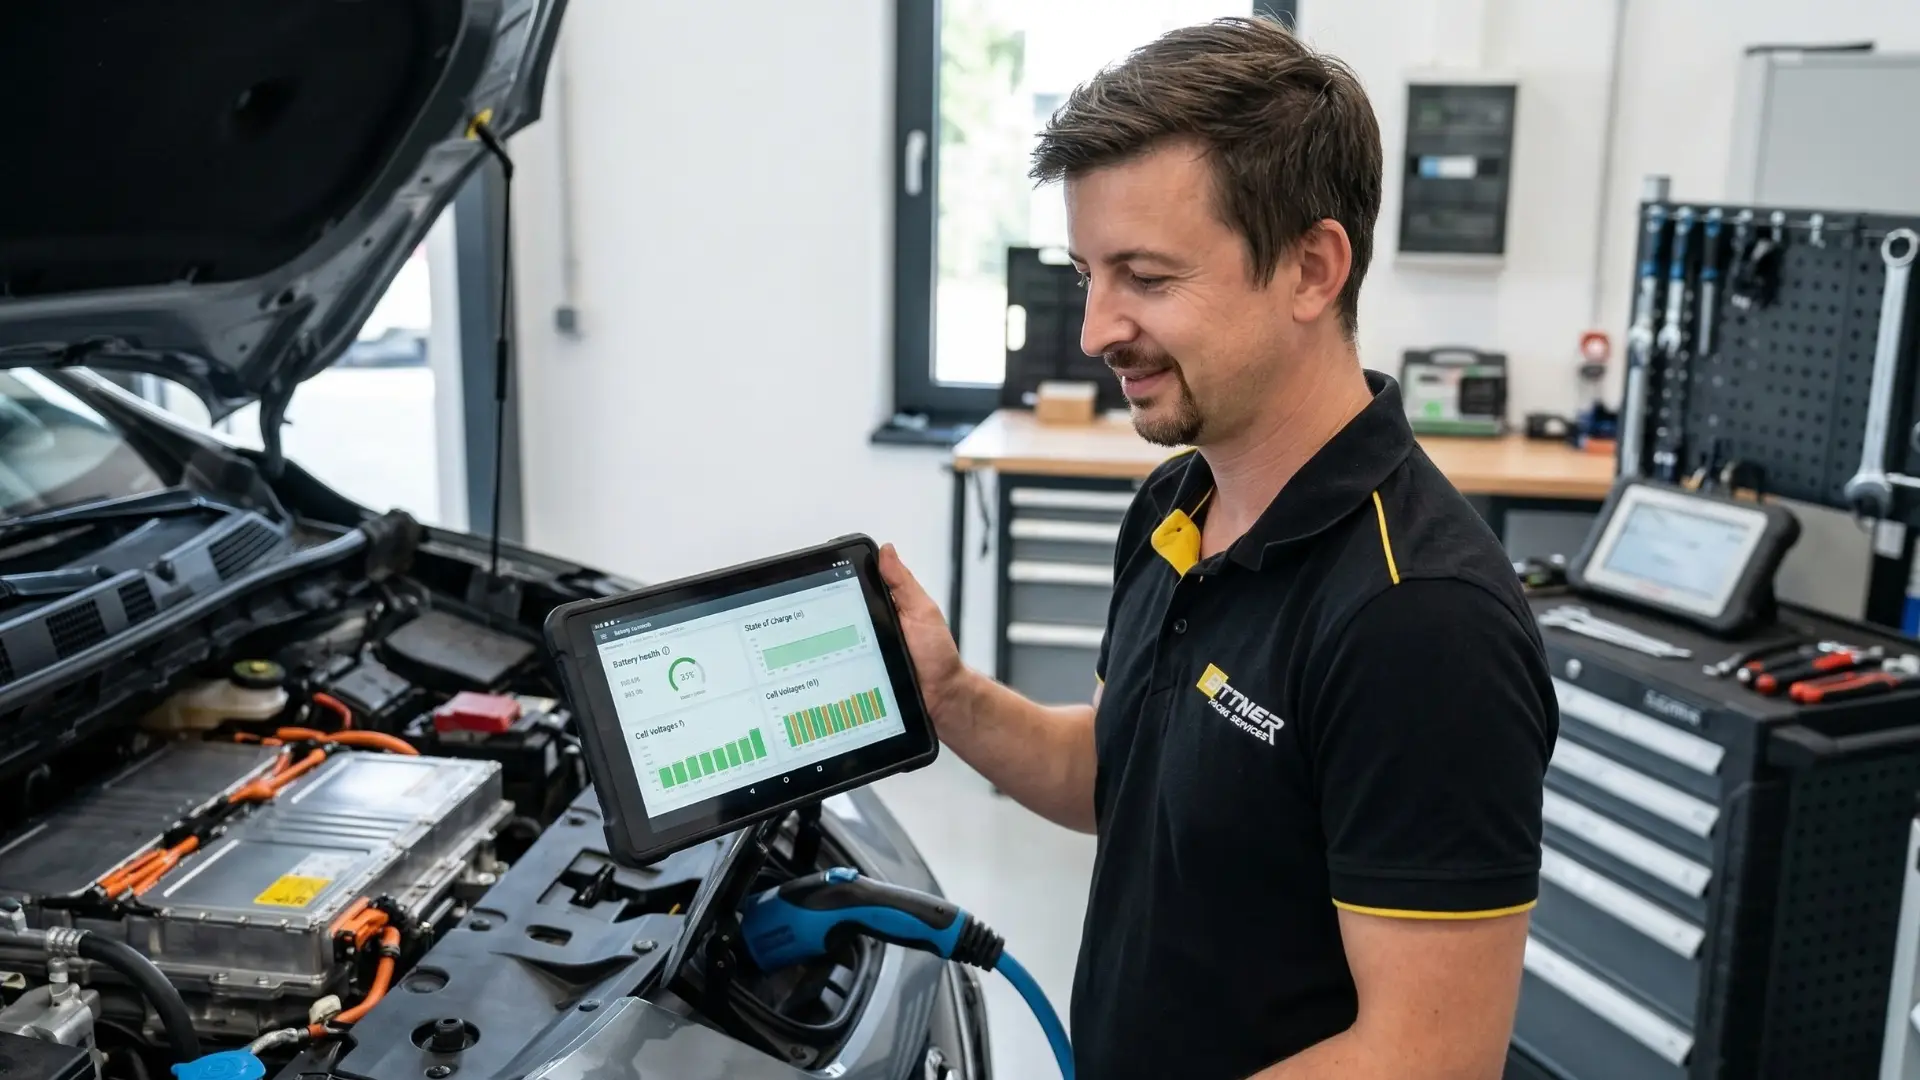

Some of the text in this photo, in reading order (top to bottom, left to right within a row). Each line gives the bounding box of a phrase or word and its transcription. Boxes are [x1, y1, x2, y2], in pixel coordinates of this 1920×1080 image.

[744, 623, 762, 632] State
[762, 618, 769, 627] of
[770, 614, 793, 624] Charge
[612, 649, 661, 669] Battery health
[765, 690, 779, 700] Cell
[778, 683, 806, 695] Voltages
[635, 729, 649, 740] Cell
[649, 722, 679, 735] Voltages
